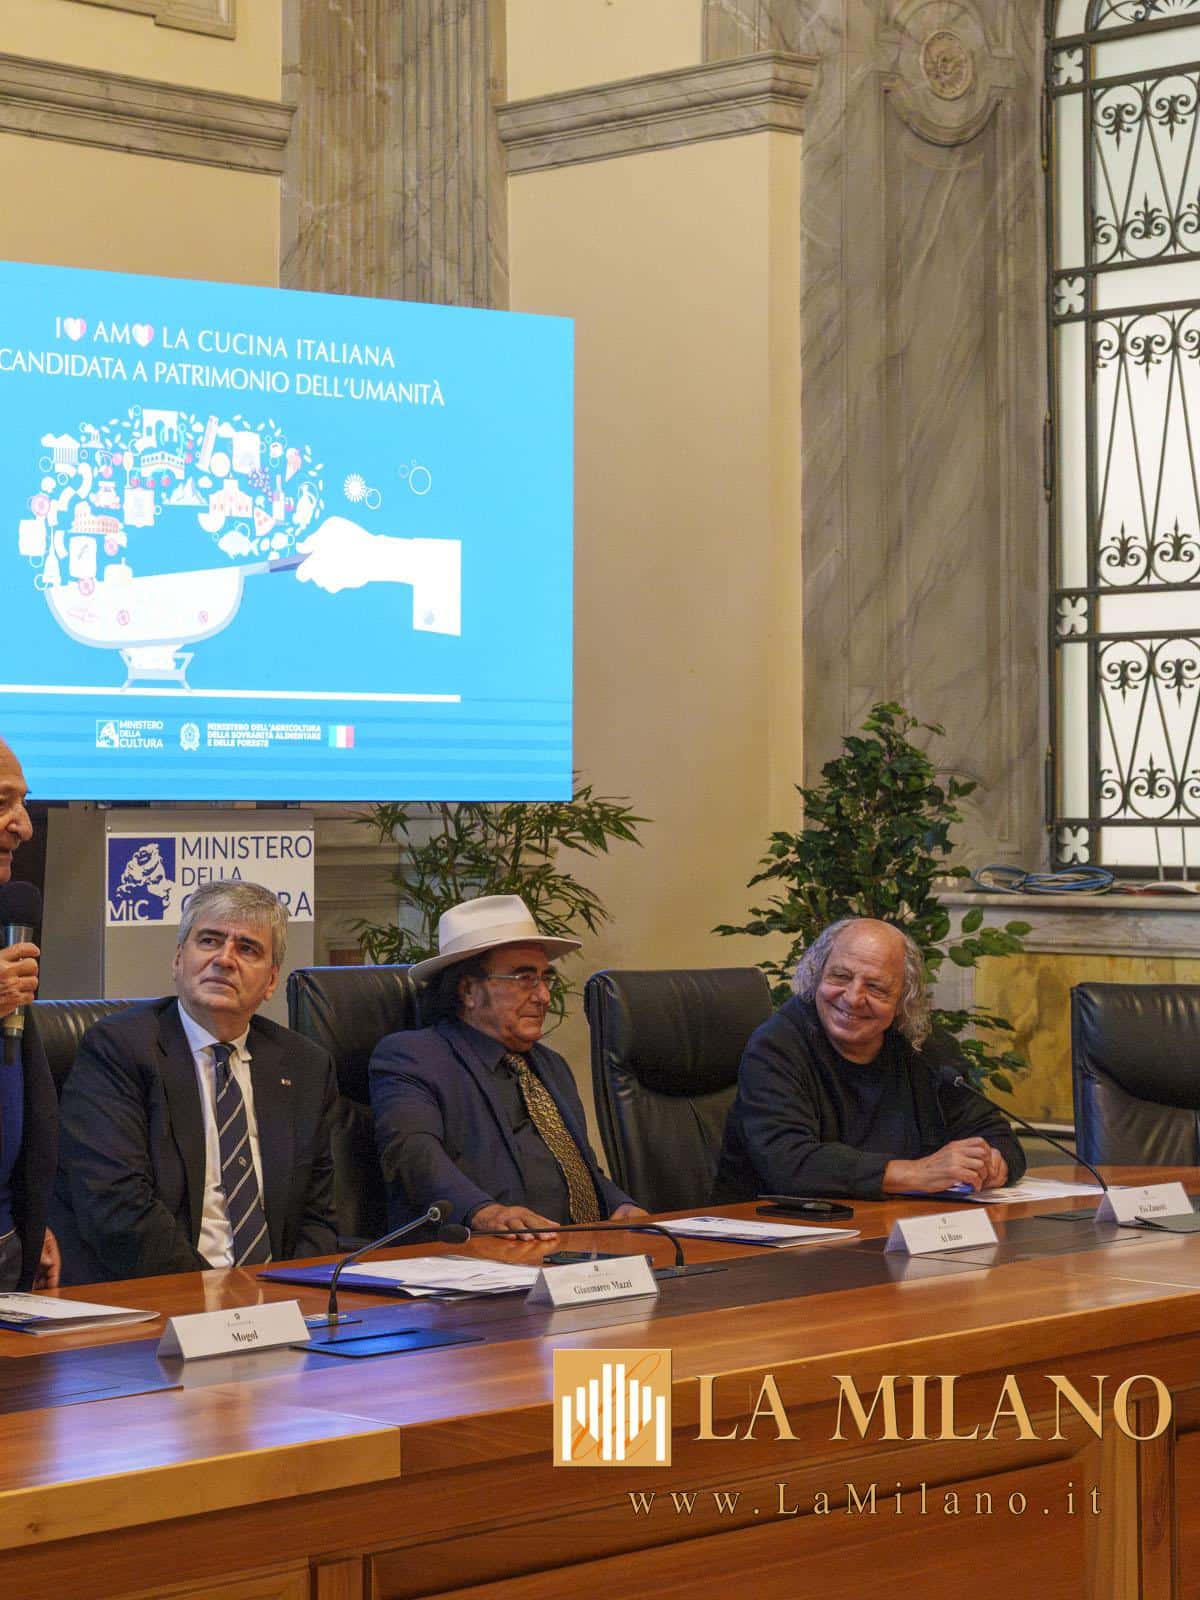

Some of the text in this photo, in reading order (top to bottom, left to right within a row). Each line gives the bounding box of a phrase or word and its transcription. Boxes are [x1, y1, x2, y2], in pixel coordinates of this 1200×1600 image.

[162, 327, 190, 351] LA
[198, 330, 288, 360] CUCINA
[297, 339, 395, 369] ITALIANA
[133, 360, 149, 383] A
[155, 363, 290, 394] PATRIMONIO
[181, 835, 313, 860] MINISTERO
[231, 1329, 258, 1342] Mogol
